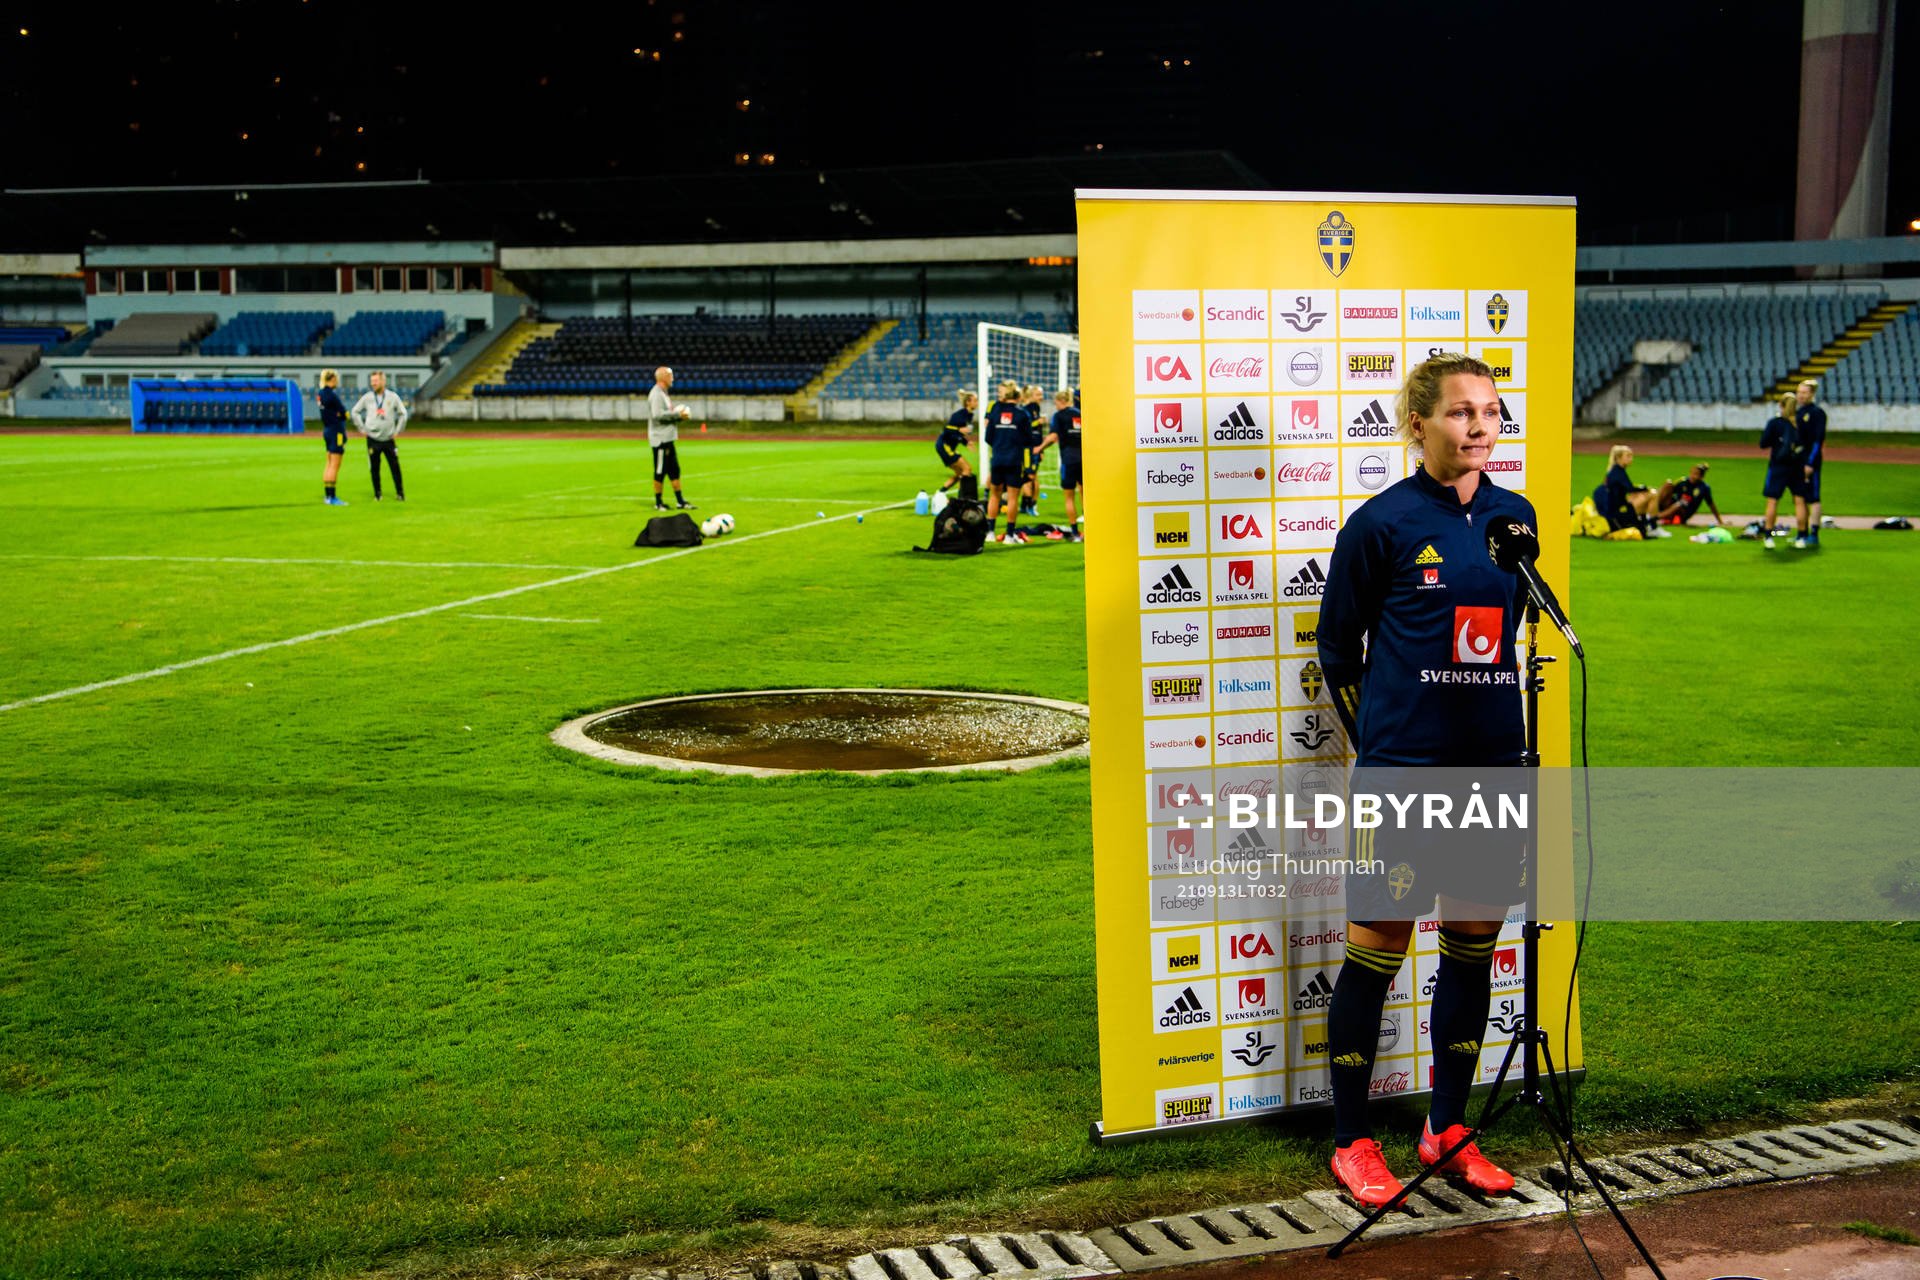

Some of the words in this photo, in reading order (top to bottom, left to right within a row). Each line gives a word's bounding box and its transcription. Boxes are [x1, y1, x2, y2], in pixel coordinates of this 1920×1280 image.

[1296, 296, 1311, 313] SJ
[1138, 311, 1180, 319] Swedbank
[1208, 306, 1264, 321] Scandic
[1344, 308, 1397, 319] BAUHAUS
[1411, 307, 1460, 320] Folksam
[1146, 356, 1192, 381] ICA
[1349, 355, 1394, 372] SPORT
[1214, 426, 1263, 441] adidas
[1316, 432, 1333, 440] SPEL
[1348, 423, 1396, 437] adidas
[1140, 436, 1177, 444] SVENSKA
[1148, 470, 1194, 487] Fabege
[1214, 471, 1253, 479] Swedbank
[1222, 514, 1263, 540] ICA
[1279, 517, 1336, 532] Scandic
[1147, 588, 1201, 603] adidas
[1216, 594, 1249, 602] SVENSKA
[1251, 592, 1268, 600] SPEL
[1153, 631, 1199, 647] Fabege
[1217, 626, 1270, 639] BAUHAUS
[1420, 670, 1490, 684] SVENSKA
[1494, 672, 1516, 684] SPEL
[1152, 677, 1201, 697] SPORT
[1219, 678, 1271, 694] Folksam
[1305, 715, 1320, 731] SJ
[1150, 740, 1193, 749] Swedbank
[1217, 729, 1274, 746] Scandic
[1289, 849, 1322, 858] SVENSKA
[1324, 848, 1341, 856] SPEL
[1161, 896, 1204, 911] Fabege
[1231, 932, 1274, 960] ICA
[1289, 929, 1344, 948] Scandic
[1225, 1009, 1260, 1021] SVENSKA
[1262, 1008, 1280, 1018] SPEL
[1500, 1000, 1514, 1015] SJ
[1160, 1009, 1211, 1027] adidas
[1246, 1031, 1262, 1047] SJ
[1158, 1052, 1214, 1067] #viärsverige
[1164, 1096, 1211, 1119] SPORT
[1229, 1094, 1281, 1111] Folksam
[1167, 1114, 1209, 1124] BLADET
